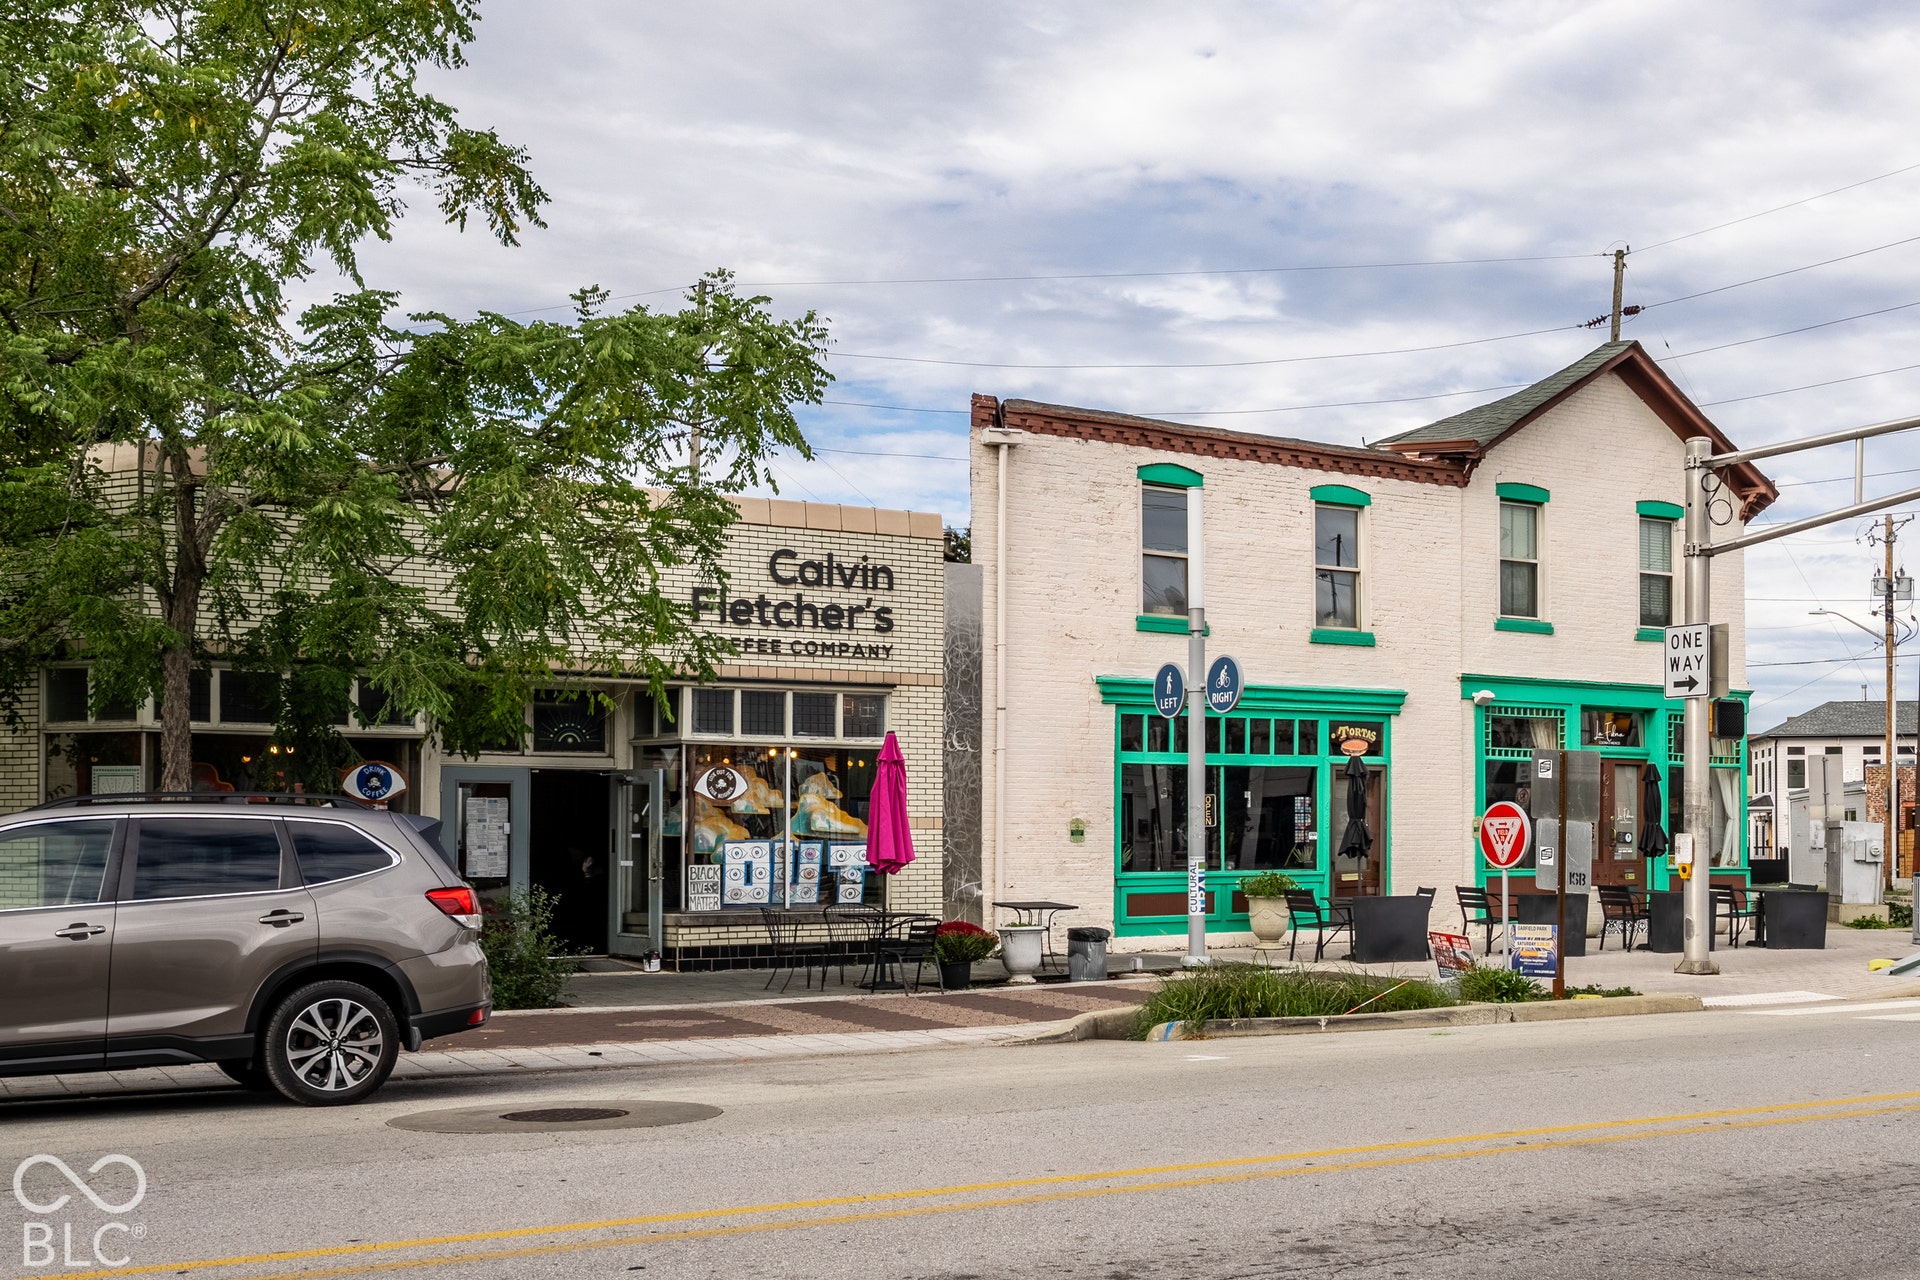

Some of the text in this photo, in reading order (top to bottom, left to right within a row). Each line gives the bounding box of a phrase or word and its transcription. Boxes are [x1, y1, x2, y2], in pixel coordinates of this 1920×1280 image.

[769, 549, 894, 590] Calvin
[692, 586, 894, 633] Fletcher's
[1671, 632, 1702, 649] ONE
[791, 640, 894, 659] COMPANY
[1670, 654, 1704, 672] WAY
[1160, 697, 1178, 709] LEFT
[1212, 691, 1233, 704] RIGHT
[363, 766, 387, 776] DRINK
[362, 786, 388, 797] COFFEE
[690, 867, 720, 880] BLACK
[691, 882, 713, 894] LIVES
[1190, 862, 1198, 913] CULTURAL
[690, 896, 719, 910] MATTER
